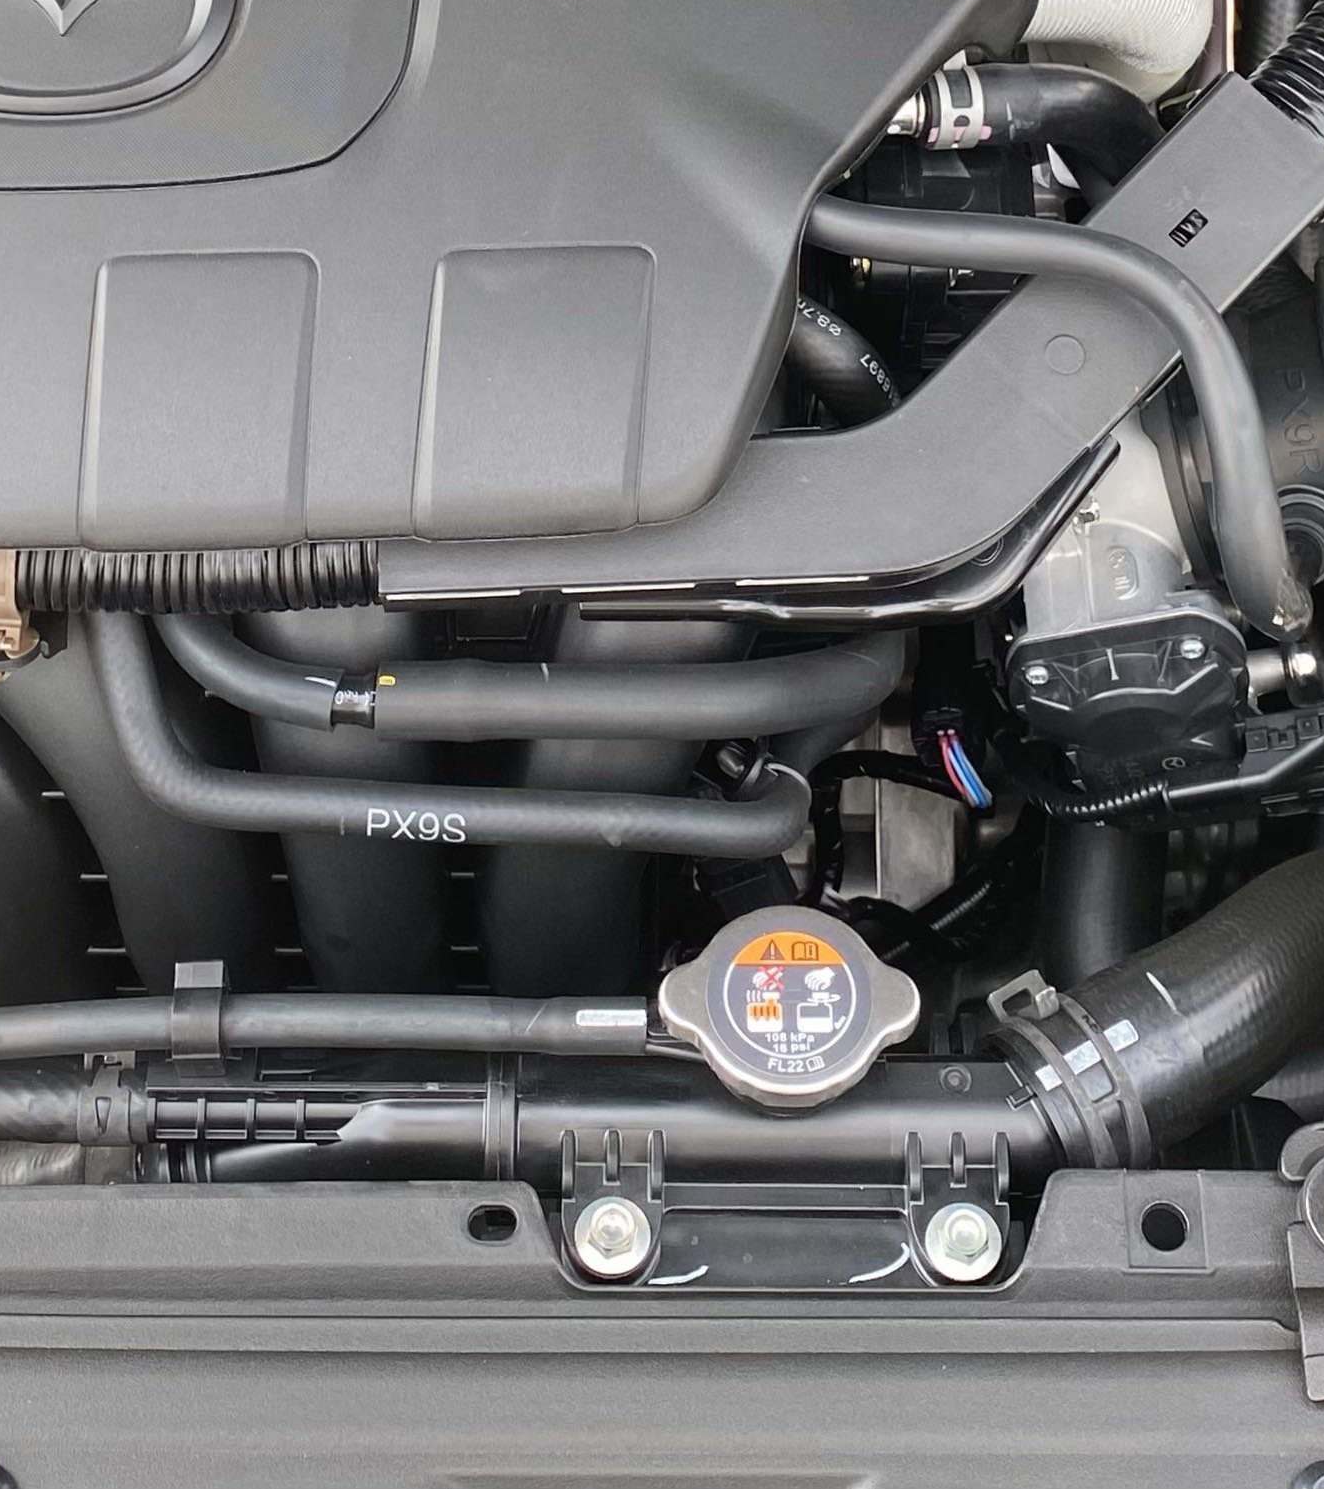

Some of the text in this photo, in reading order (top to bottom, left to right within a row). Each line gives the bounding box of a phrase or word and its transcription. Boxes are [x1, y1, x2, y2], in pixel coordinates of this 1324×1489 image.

[366, 807, 467, 843] PX9S
[765, 1032, 815, 1043] 108 kPa
[790, 1042, 810, 1054] psi
[767, 1057, 805, 1073] FL22
